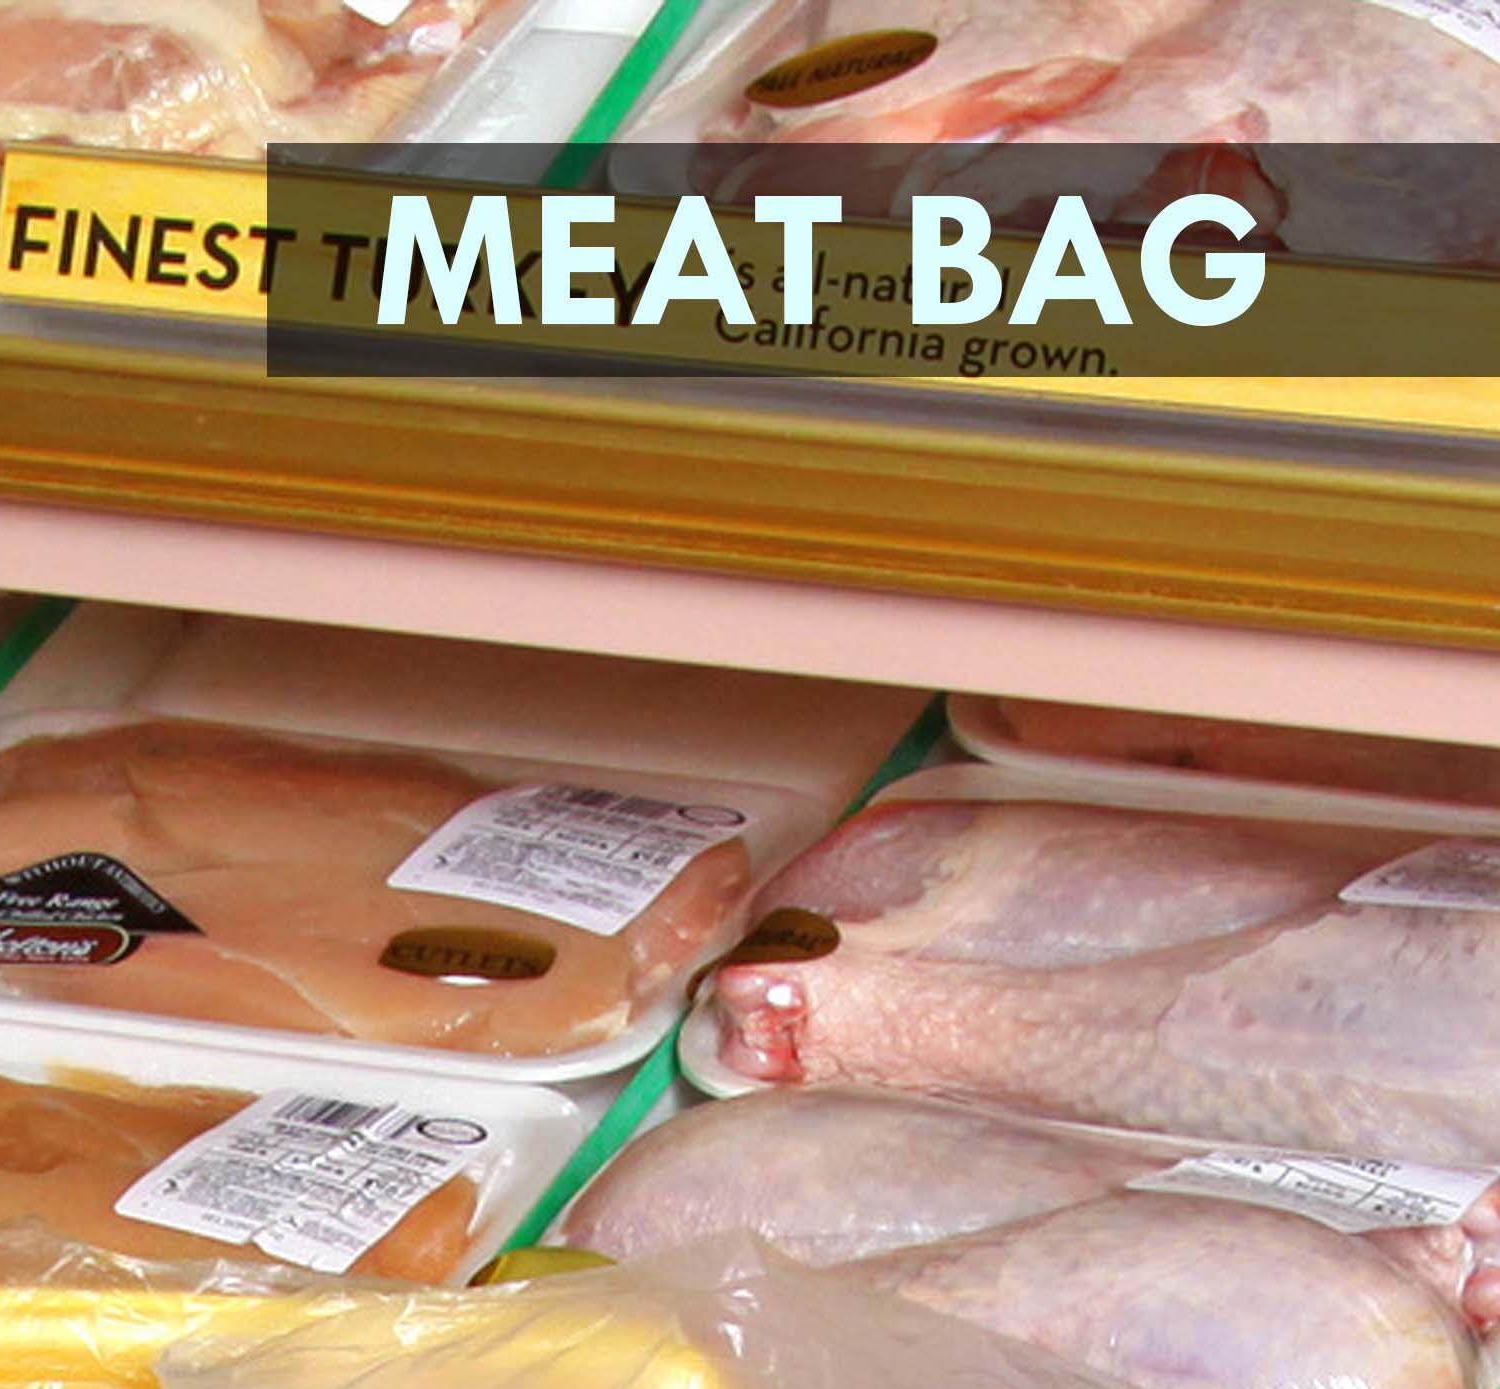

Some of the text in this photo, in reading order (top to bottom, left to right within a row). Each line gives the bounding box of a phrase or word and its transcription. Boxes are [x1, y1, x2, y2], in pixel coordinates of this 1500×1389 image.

[8, 205, 297, 295] FINEST
[958, 333, 1119, 378] grown.
[391, 942, 546, 976] CUTLETS
